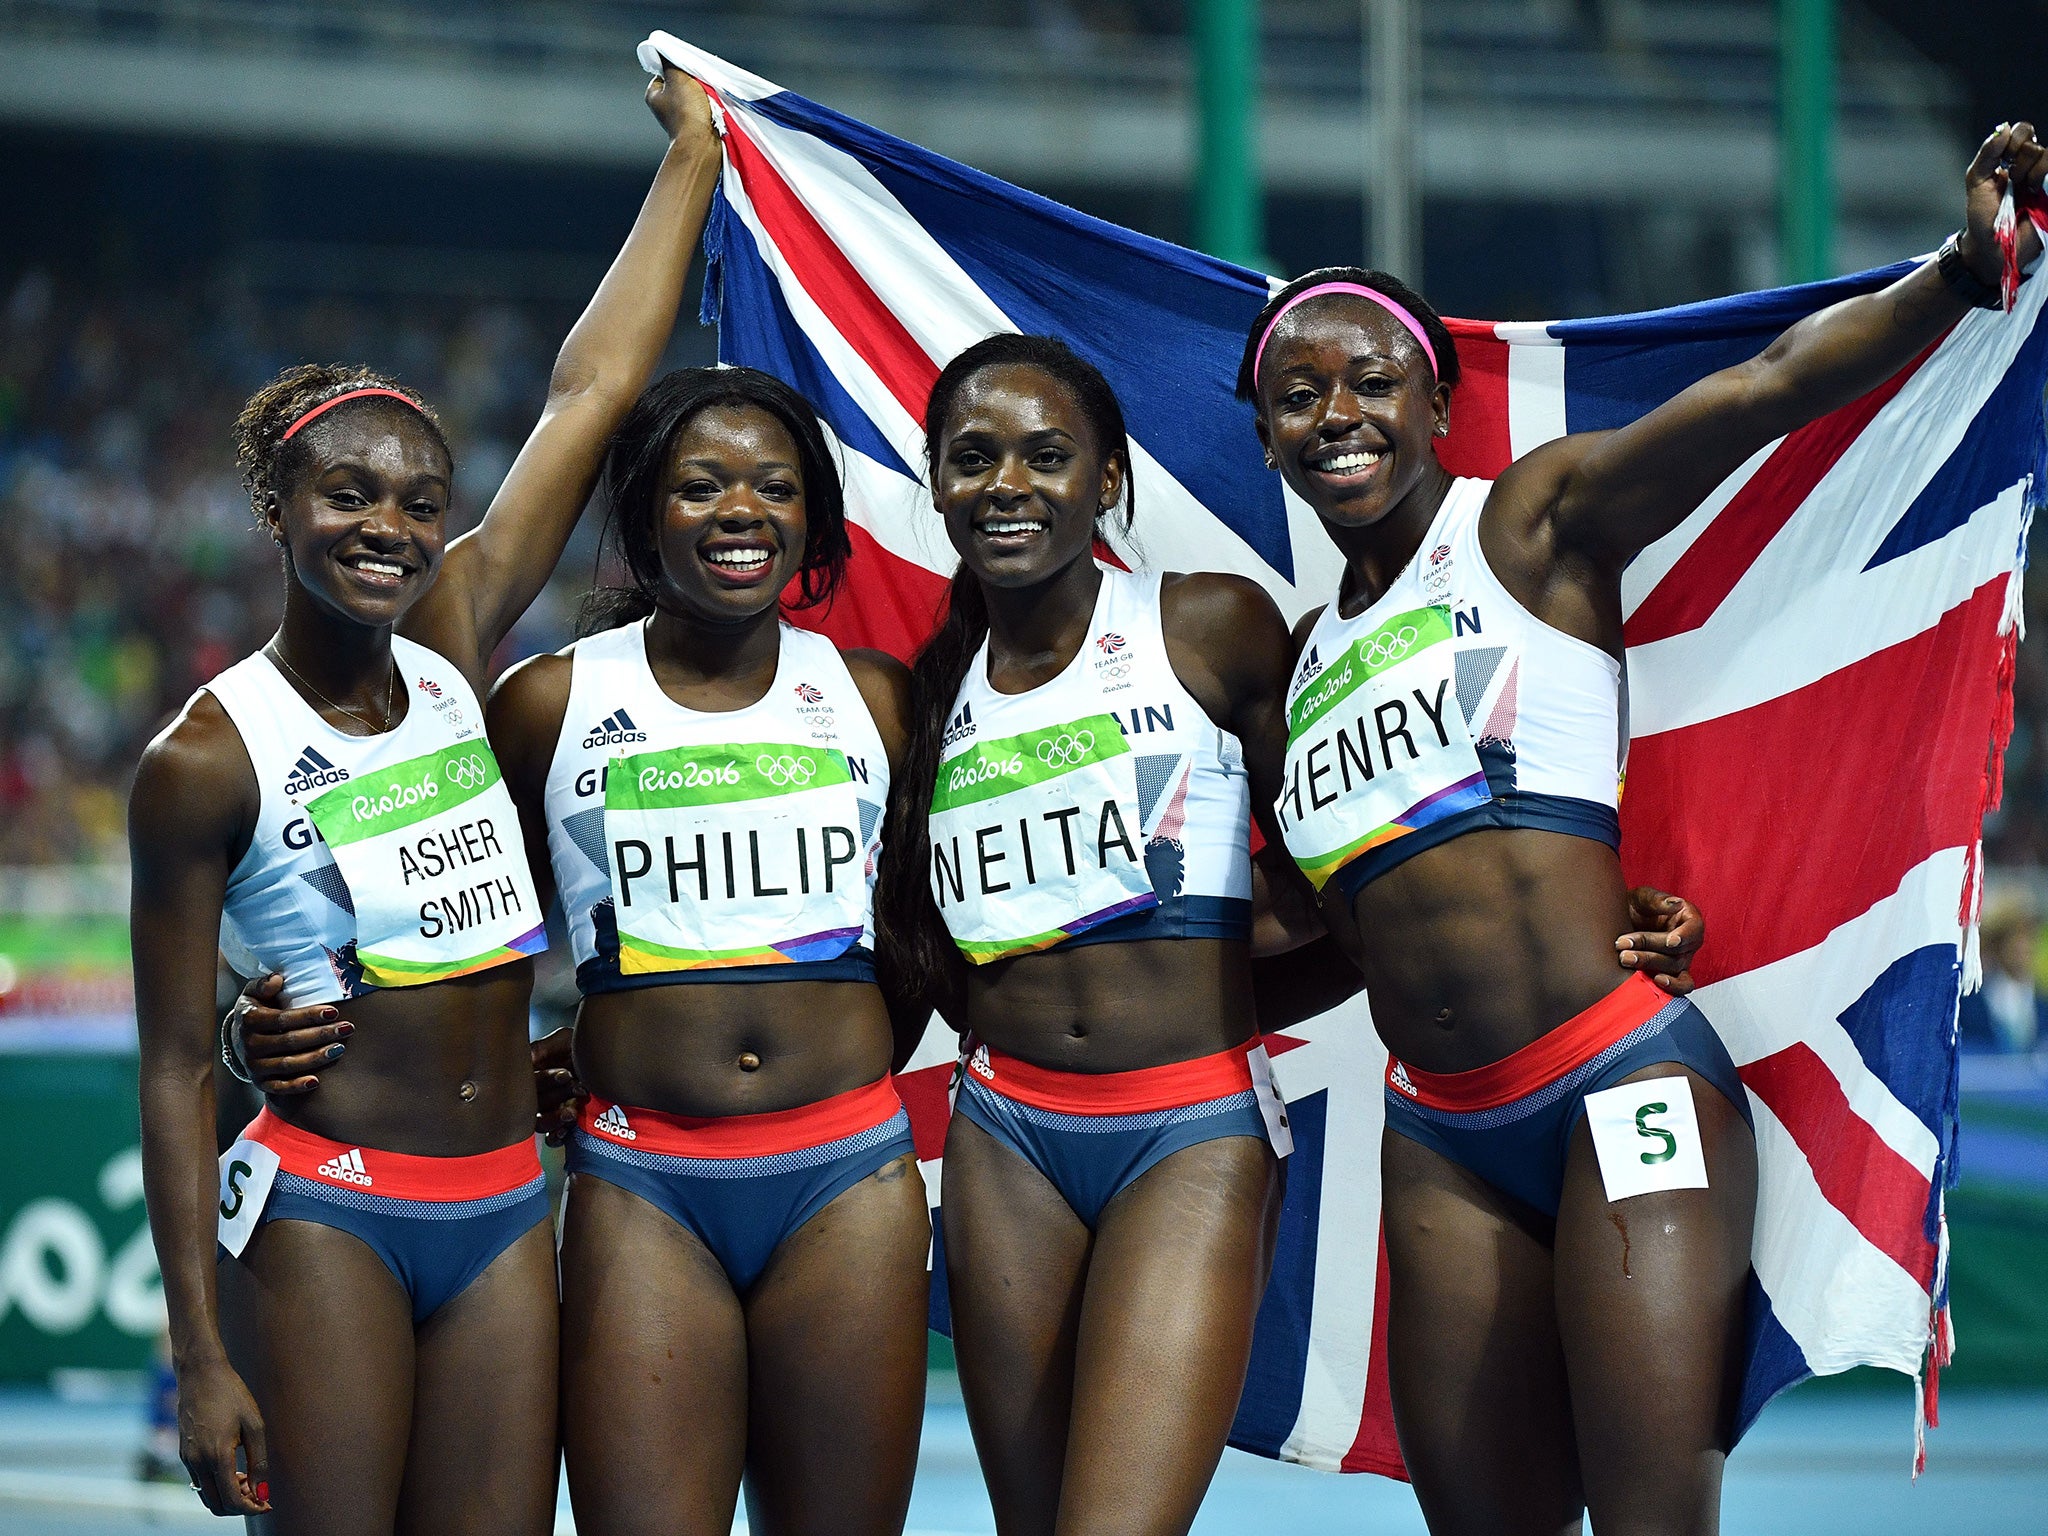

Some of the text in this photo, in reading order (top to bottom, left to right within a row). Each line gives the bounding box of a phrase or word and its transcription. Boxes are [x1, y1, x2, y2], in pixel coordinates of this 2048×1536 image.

[1423, 560, 1453, 582] TEAM GB
[1094, 653, 1133, 669] TEAM GB
[796, 706, 834, 714] TEAM GB
[1299, 659, 1353, 724] Rio2016
[583, 730, 647, 750] adidas
[940, 723, 977, 750] adidas
[1278, 679, 1450, 833] HENRY
[284, 766, 350, 795] adidas
[638, 760, 740, 792] Rio2016
[949, 752, 1023, 792] Rio2016
[351, 773, 440, 824] Rio2016
[399, 818, 504, 886] ASHER
[614, 826, 858, 907] PHILIP
[934, 799, 1139, 909] NEITA
[419, 876, 523, 939] SMITH
[594, 1117, 637, 1141] adidas
[1635, 1101, 1677, 1165] S
[219, 1160, 254, 1221] S
[317, 1162, 373, 1188] adidas
